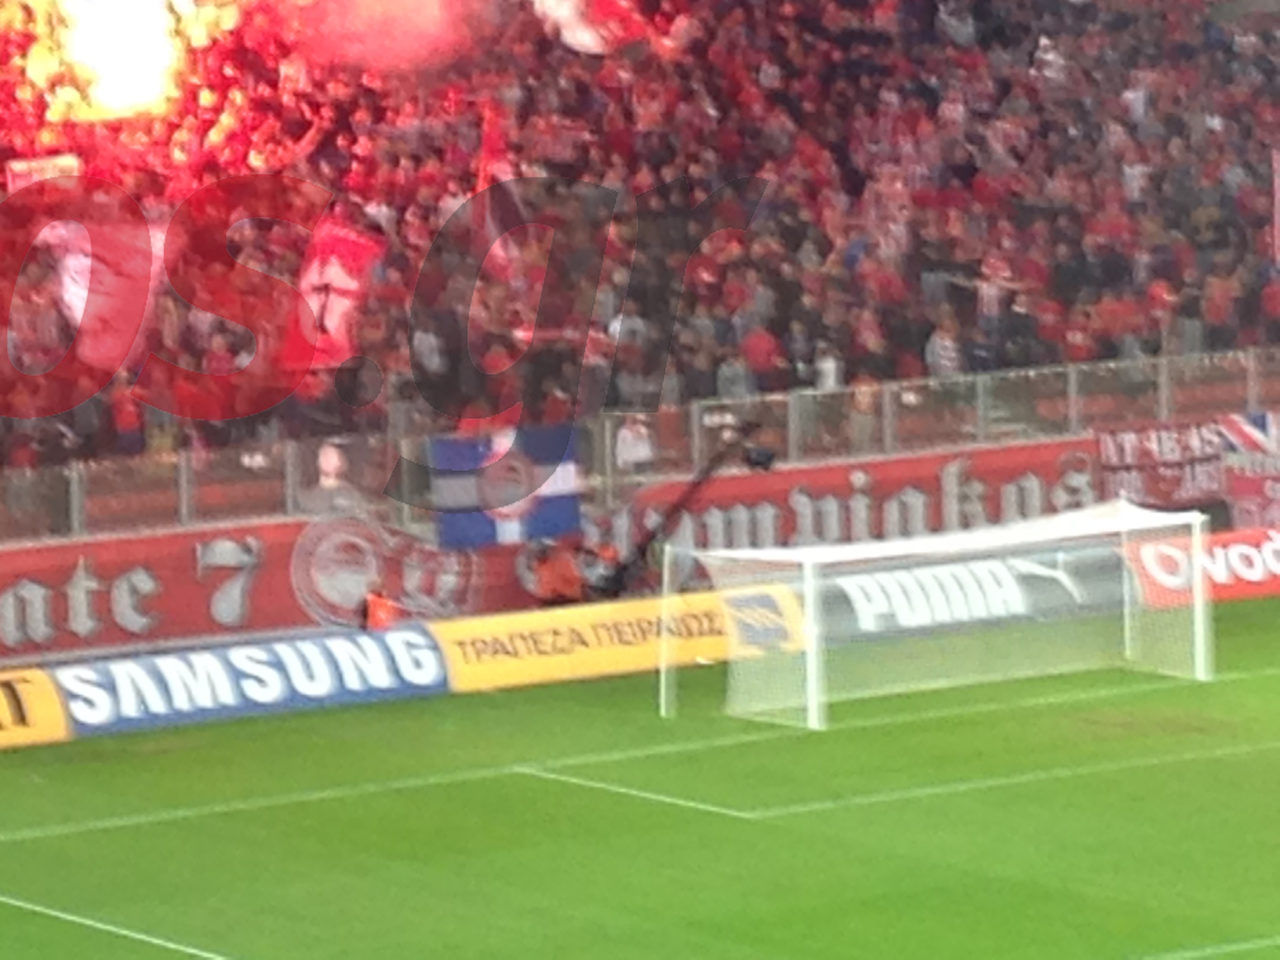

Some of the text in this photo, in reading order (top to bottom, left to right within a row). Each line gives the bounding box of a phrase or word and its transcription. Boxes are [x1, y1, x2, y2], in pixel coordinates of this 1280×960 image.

[195, 536, 263, 628] 7
[834, 558, 1028, 632] PUMA
[53, 625, 446, 728] SAMSUNG
[456, 624, 590, 667] ΤΡΑΠΕΖΑ
